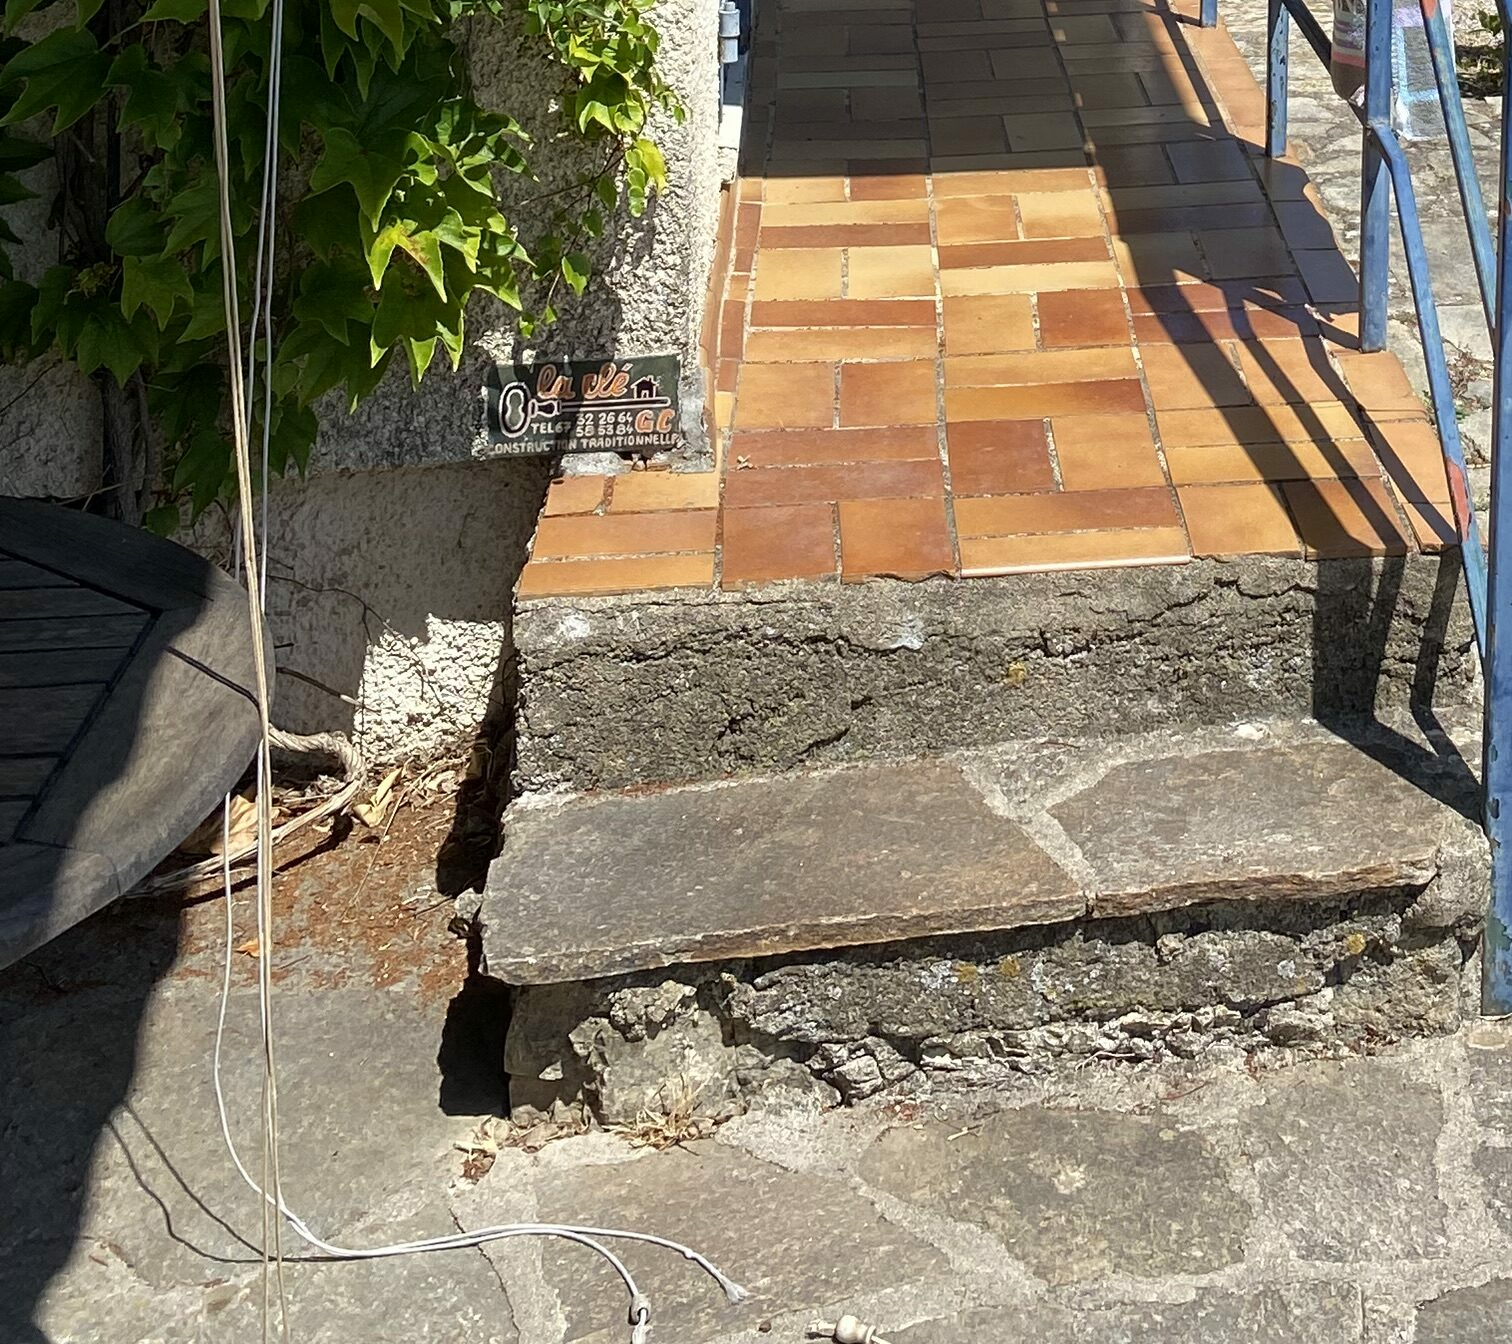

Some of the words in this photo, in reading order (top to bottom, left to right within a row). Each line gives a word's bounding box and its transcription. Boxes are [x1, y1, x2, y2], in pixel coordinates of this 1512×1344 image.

[537, 364, 576, 400] la
[582, 362, 634, 399] clé
[576, 412, 594, 426] 32
[598, 412, 616, 425] 26
[617, 411, 633, 424] 64
[530, 422, 554, 435] TEL
[575, 425, 595, 437] 58
[598, 424, 614, 436] 53
[615, 423, 634, 435] 84
